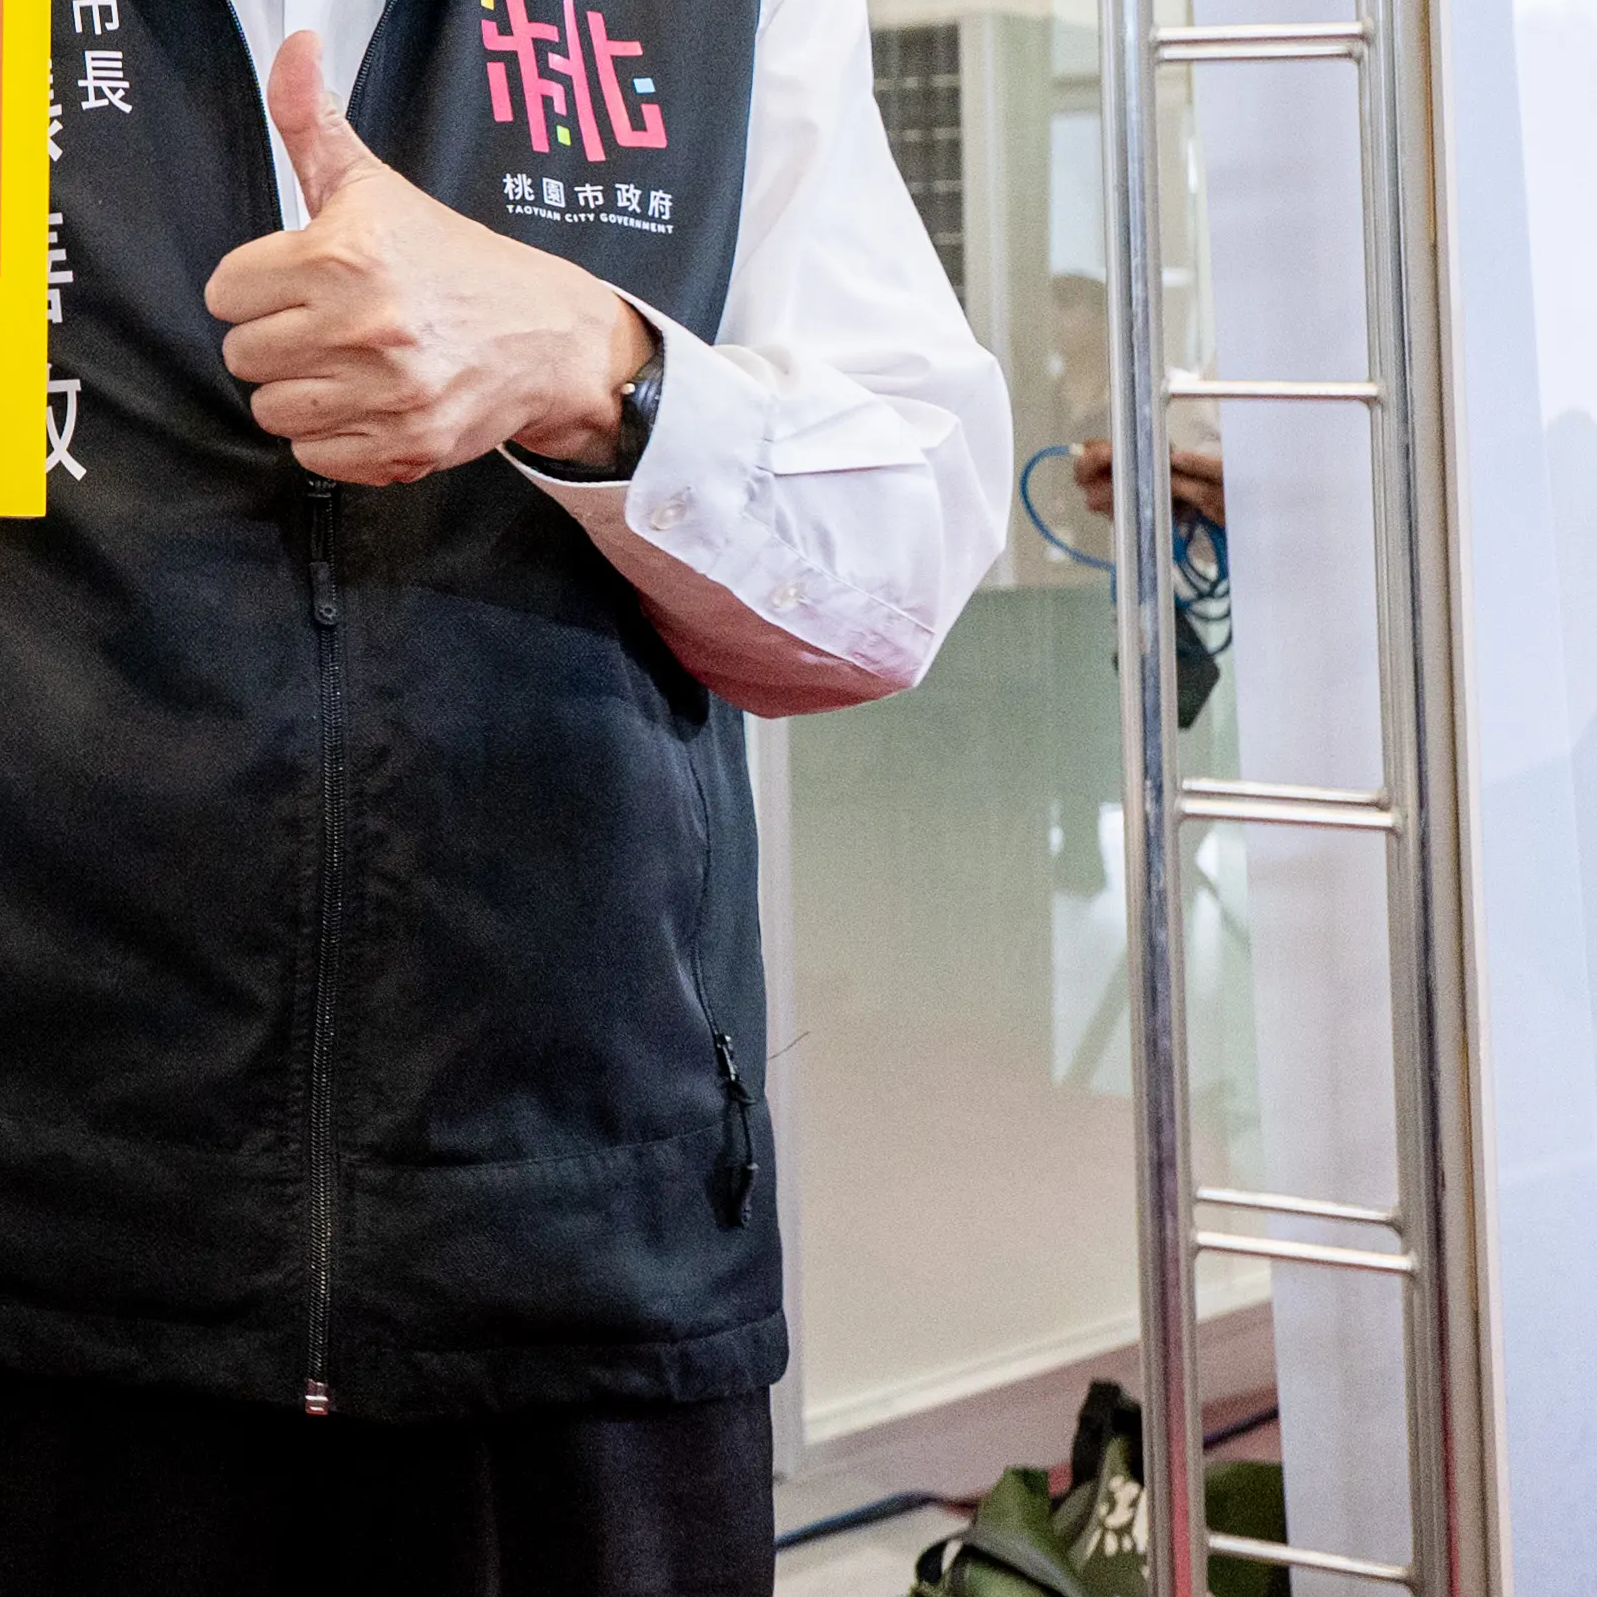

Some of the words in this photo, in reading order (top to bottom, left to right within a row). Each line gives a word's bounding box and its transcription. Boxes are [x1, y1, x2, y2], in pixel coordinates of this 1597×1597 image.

[502, 173, 673, 220] 桃園市政府
[506, 204, 561, 222] TAOYUAN
[565, 213, 595, 223] CITY
[600, 213, 674, 234] GOVERNMENT
